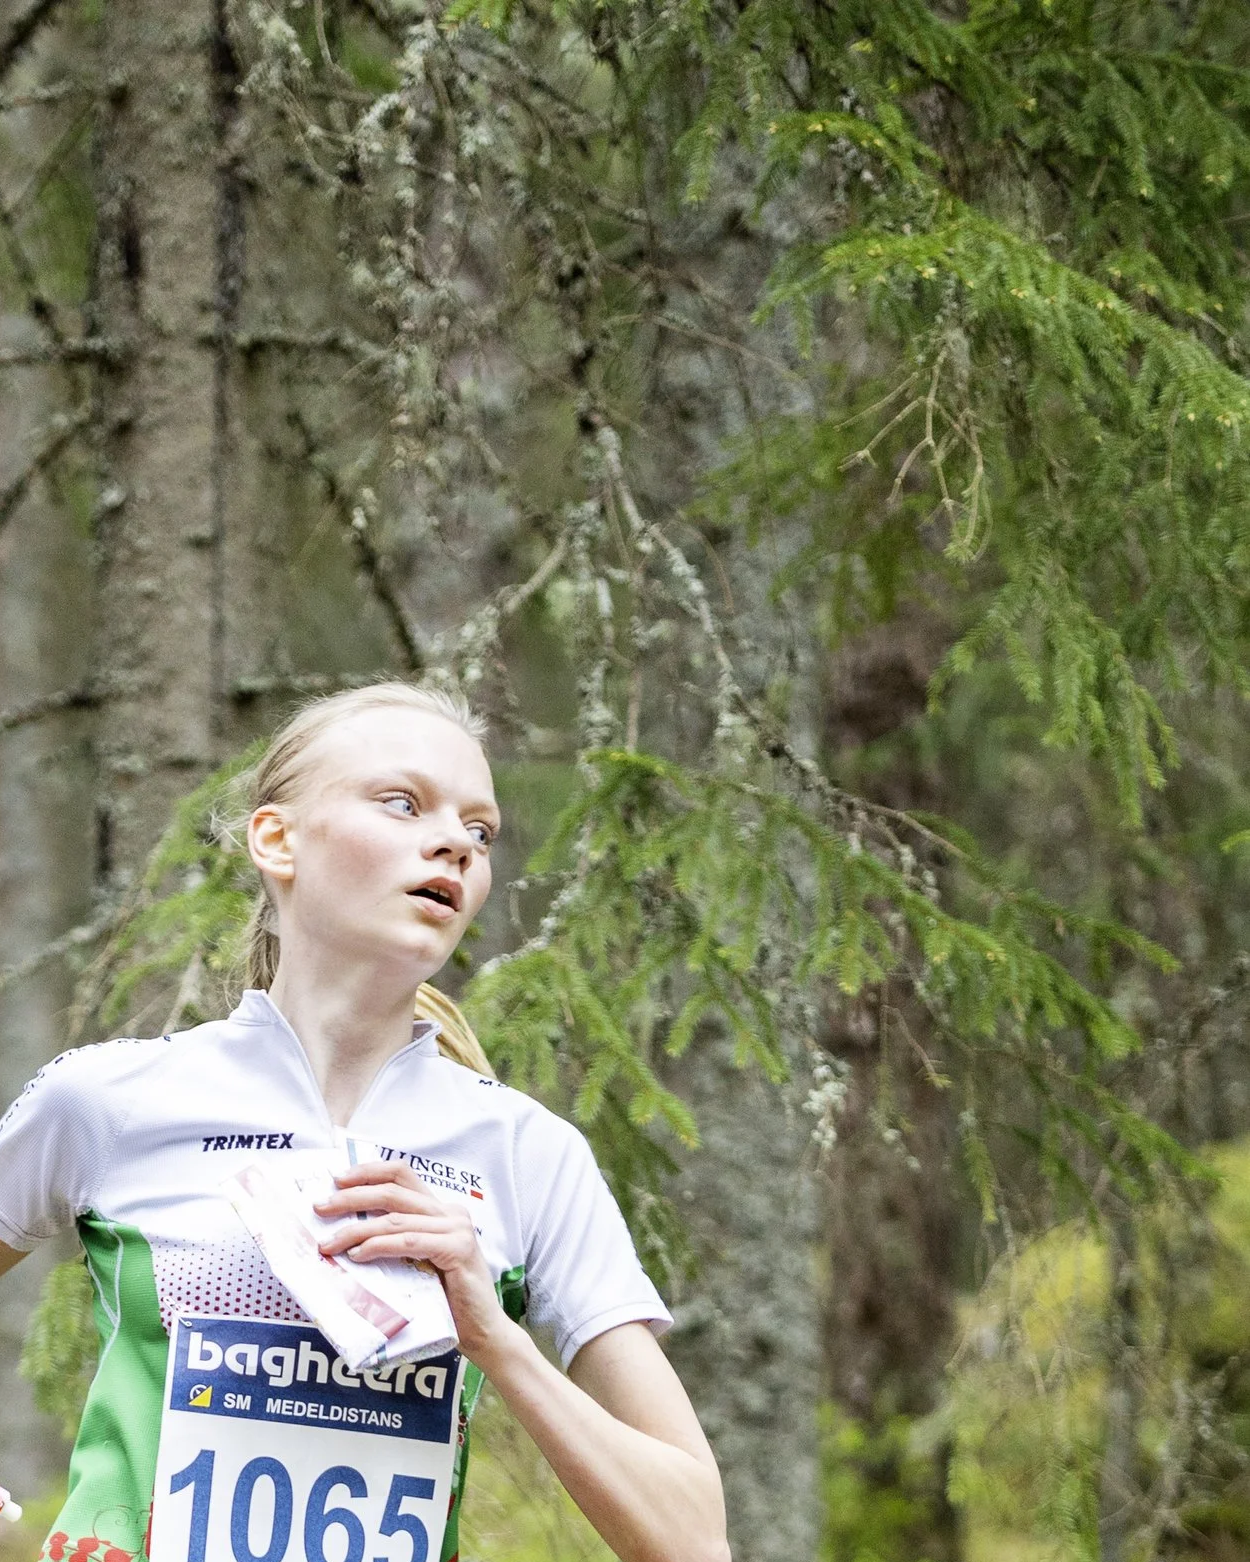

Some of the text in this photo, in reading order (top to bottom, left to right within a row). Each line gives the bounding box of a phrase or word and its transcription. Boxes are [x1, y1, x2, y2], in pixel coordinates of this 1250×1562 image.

[202, 1133, 295, 1152] TRIMTEX
[460, 1170, 483, 1190] SK
[187, 1332, 448, 1400] bagheera
[223, 1392, 403, 1429] SM MEDELDISTANS
